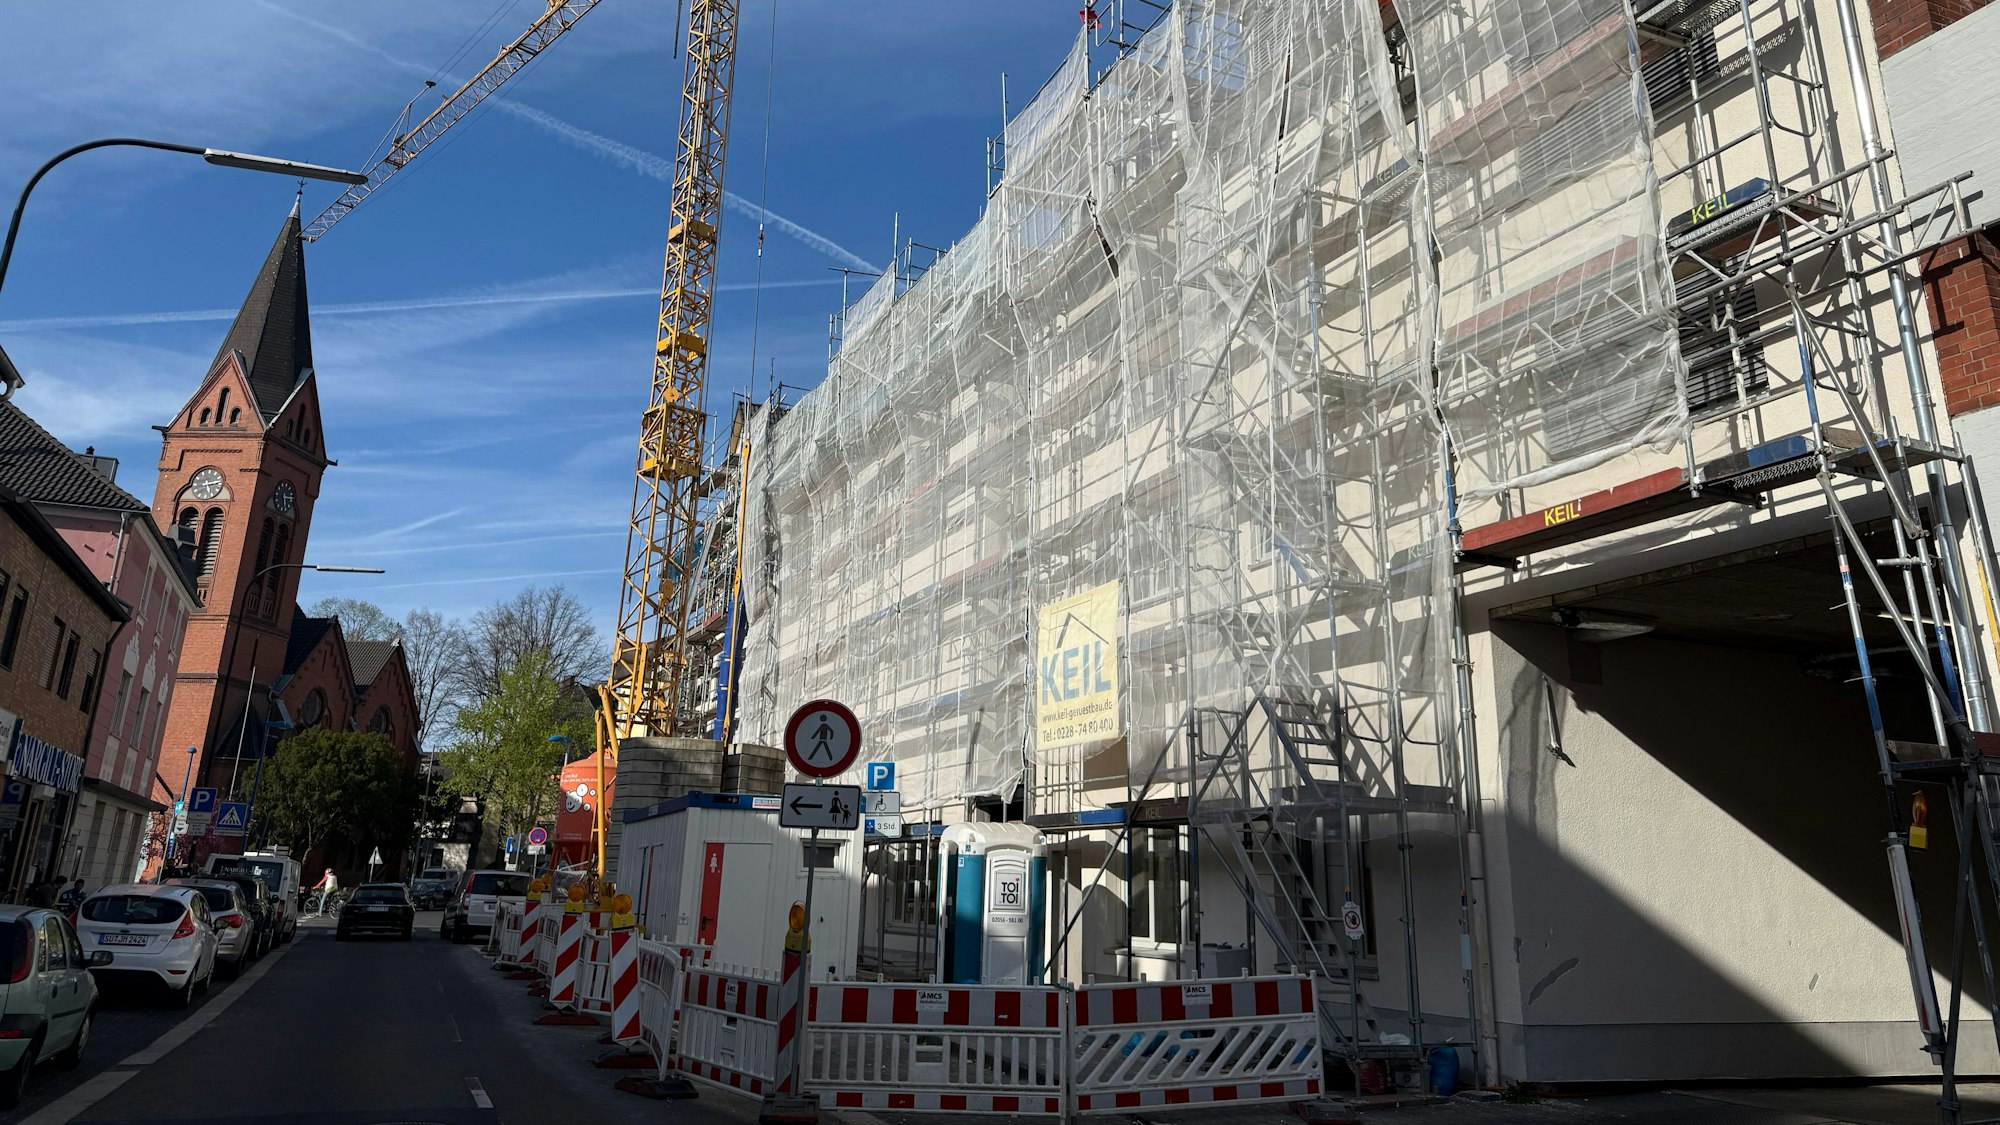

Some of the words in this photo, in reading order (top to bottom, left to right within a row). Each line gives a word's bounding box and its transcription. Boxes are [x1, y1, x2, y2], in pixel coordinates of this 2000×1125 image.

[1691, 193, 1734, 224] KEIL
[1544, 501, 1580, 527] KEIL
[1041, 641, 1112, 706] KEIL
[1042, 699, 1113, 723] www.keil-geruestbau.de
[1057, 725, 1074, 740] 0228
[1078, 723, 1087, 736] 74
[1088, 720, 1098, 733] 80
[1100, 718, 1113, 732] 400
[873, 766, 889, 787] P
[194, 790, 211, 810] P
[1145, 806, 1162, 819] KEIL
[883, 822, 897, 830] Std.
[1001, 893, 1019, 904] TOI
[129, 936, 147, 945] 2424
[927, 992, 943, 1000] MCS
